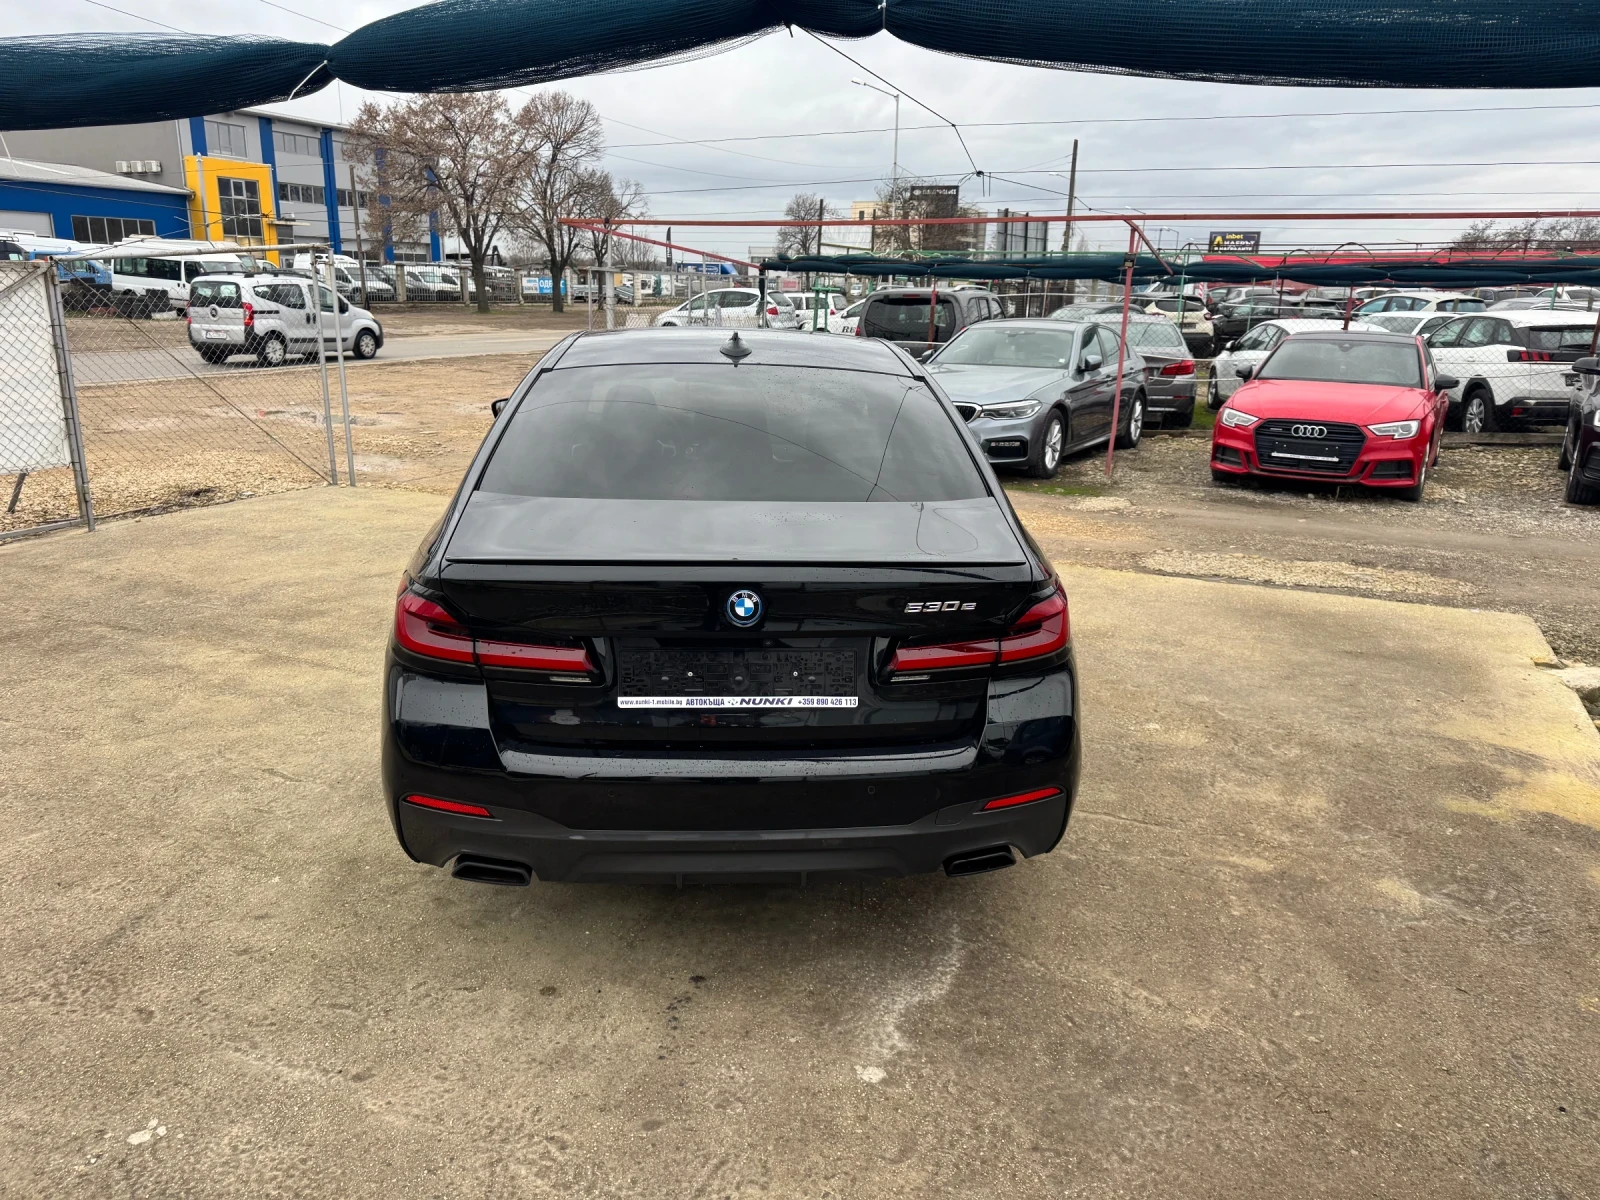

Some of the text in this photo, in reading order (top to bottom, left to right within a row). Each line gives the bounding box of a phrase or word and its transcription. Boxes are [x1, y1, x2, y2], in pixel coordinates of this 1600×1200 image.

[731, 592, 758, 604] BMW
[904, 600, 977, 614] 530e
[619, 697, 857, 707] www.nunki-1.mobile.bg АВТОКЪЩА NUNKI +359 890 426 113
